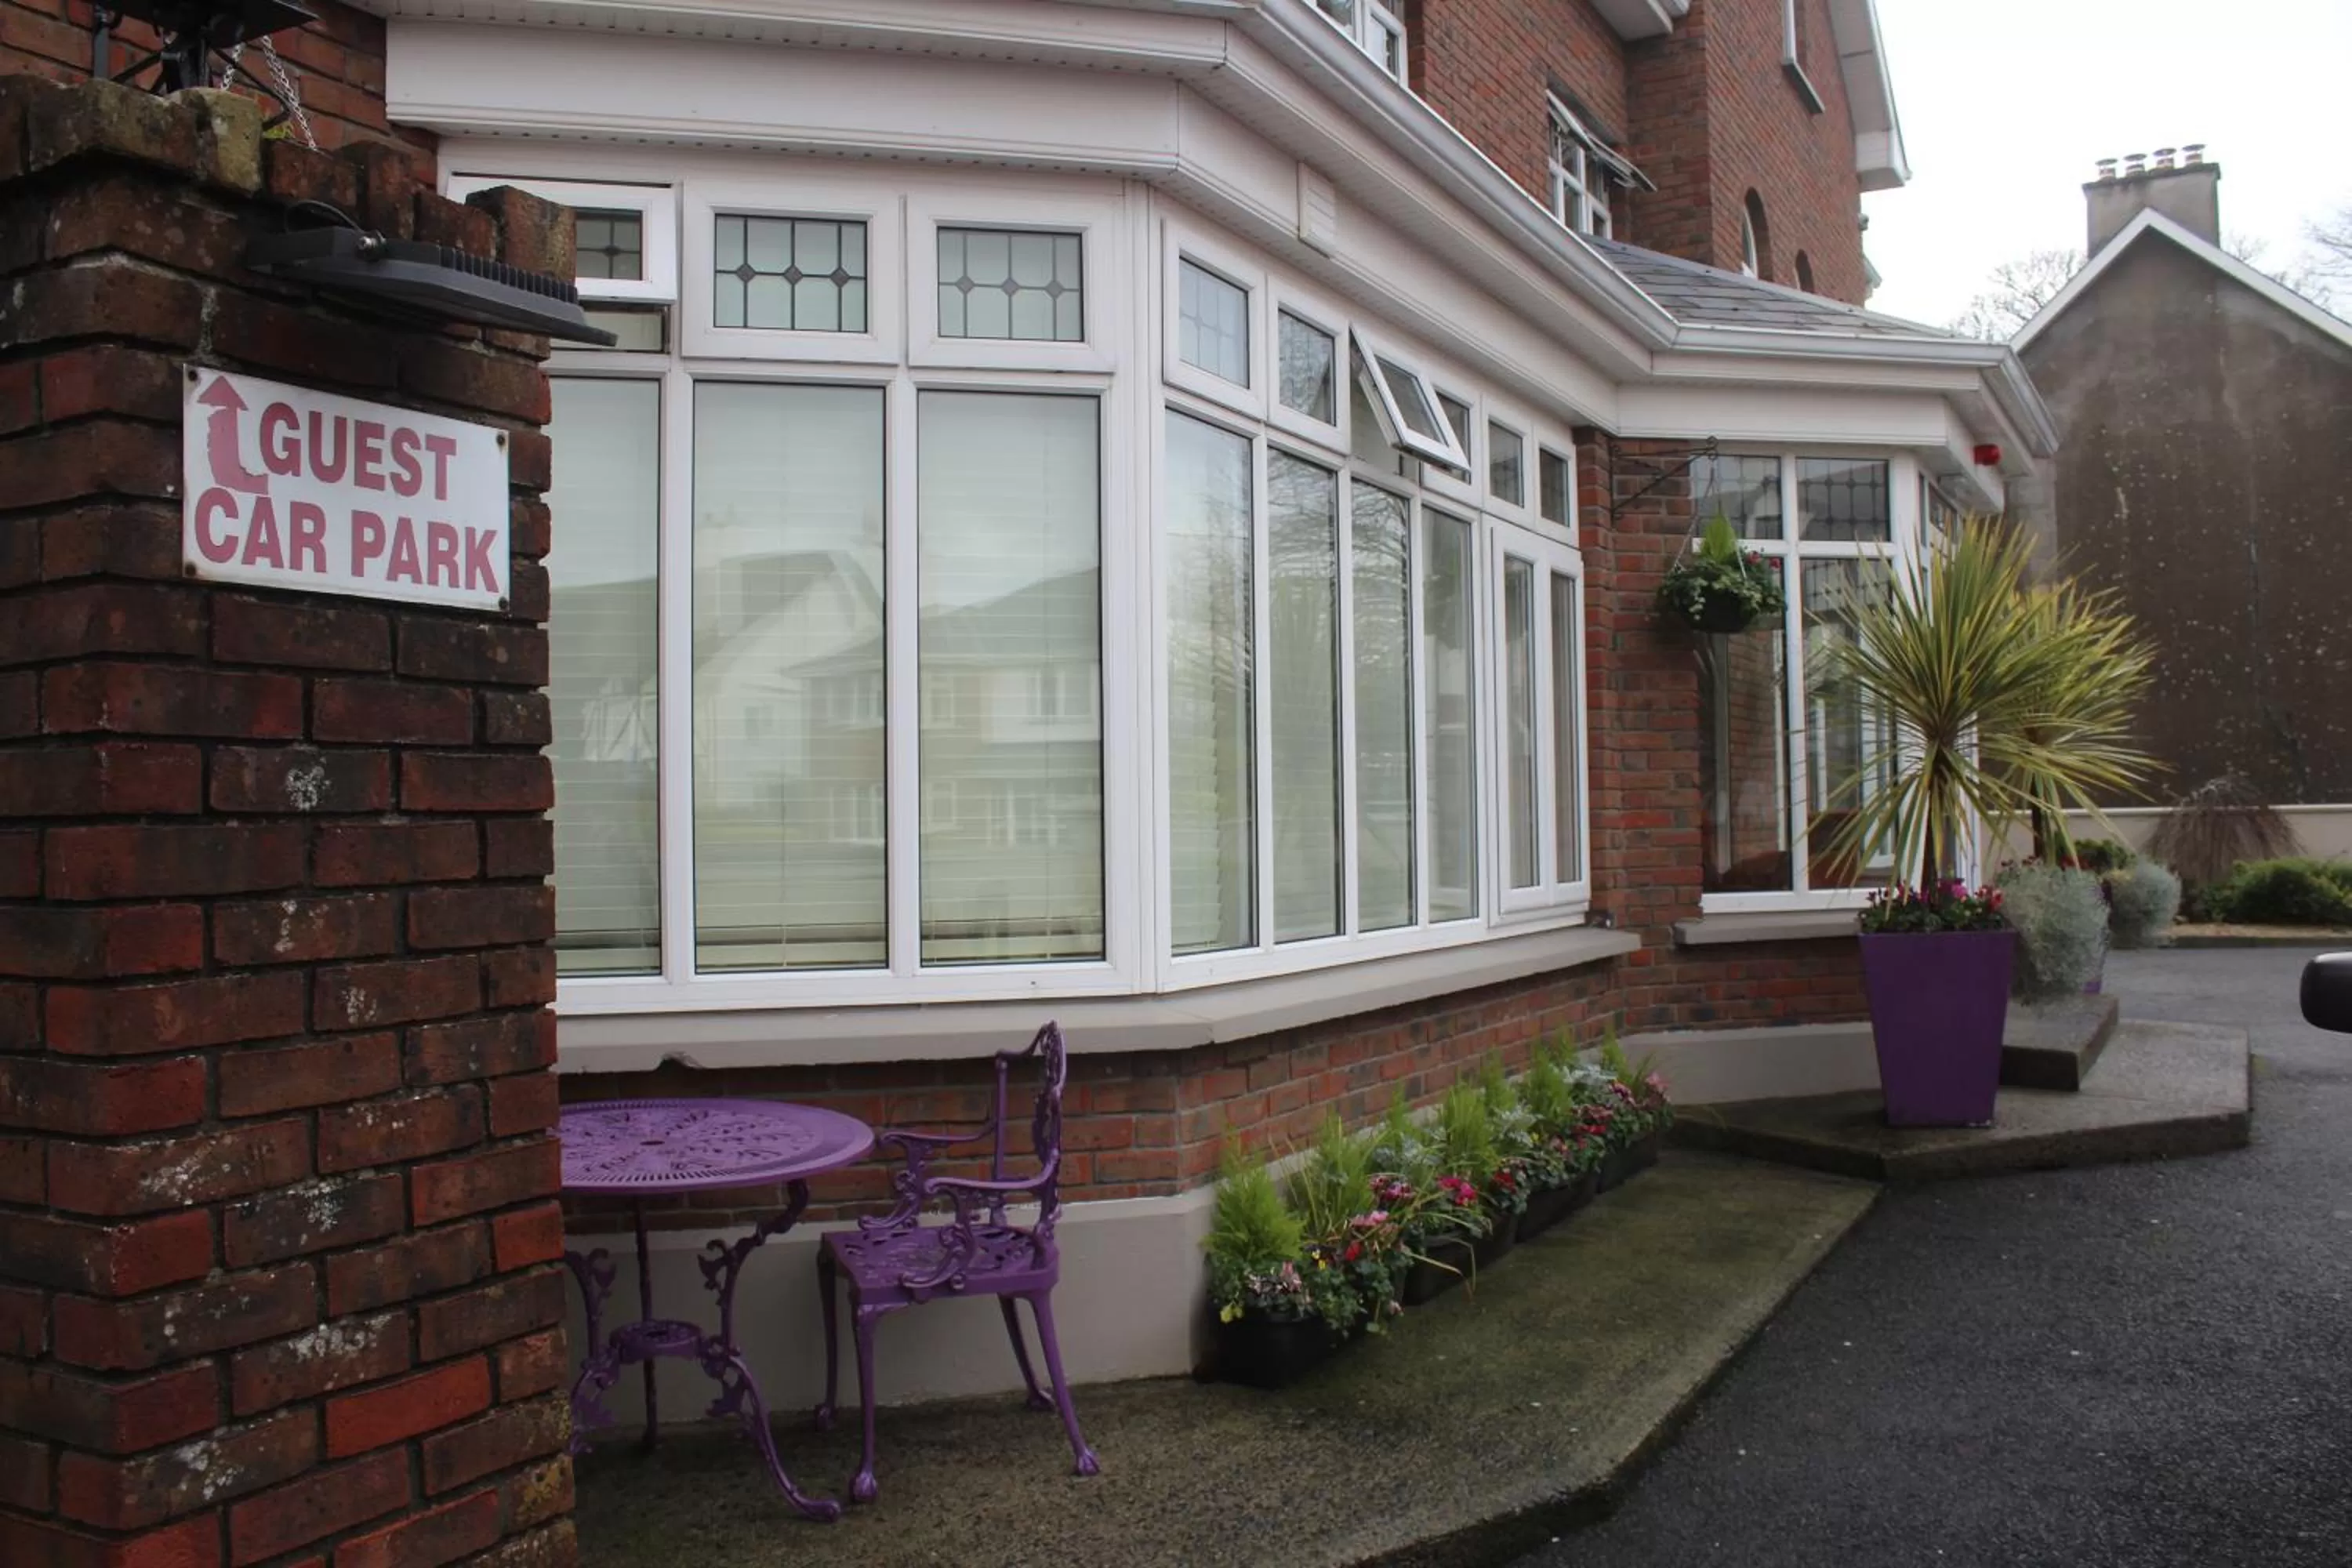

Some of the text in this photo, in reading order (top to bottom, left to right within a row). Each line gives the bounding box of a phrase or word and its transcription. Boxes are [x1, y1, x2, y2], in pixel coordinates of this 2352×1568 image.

[260, 402, 456, 500] GUEST
[194, 487, 499, 593] CAR PARK
